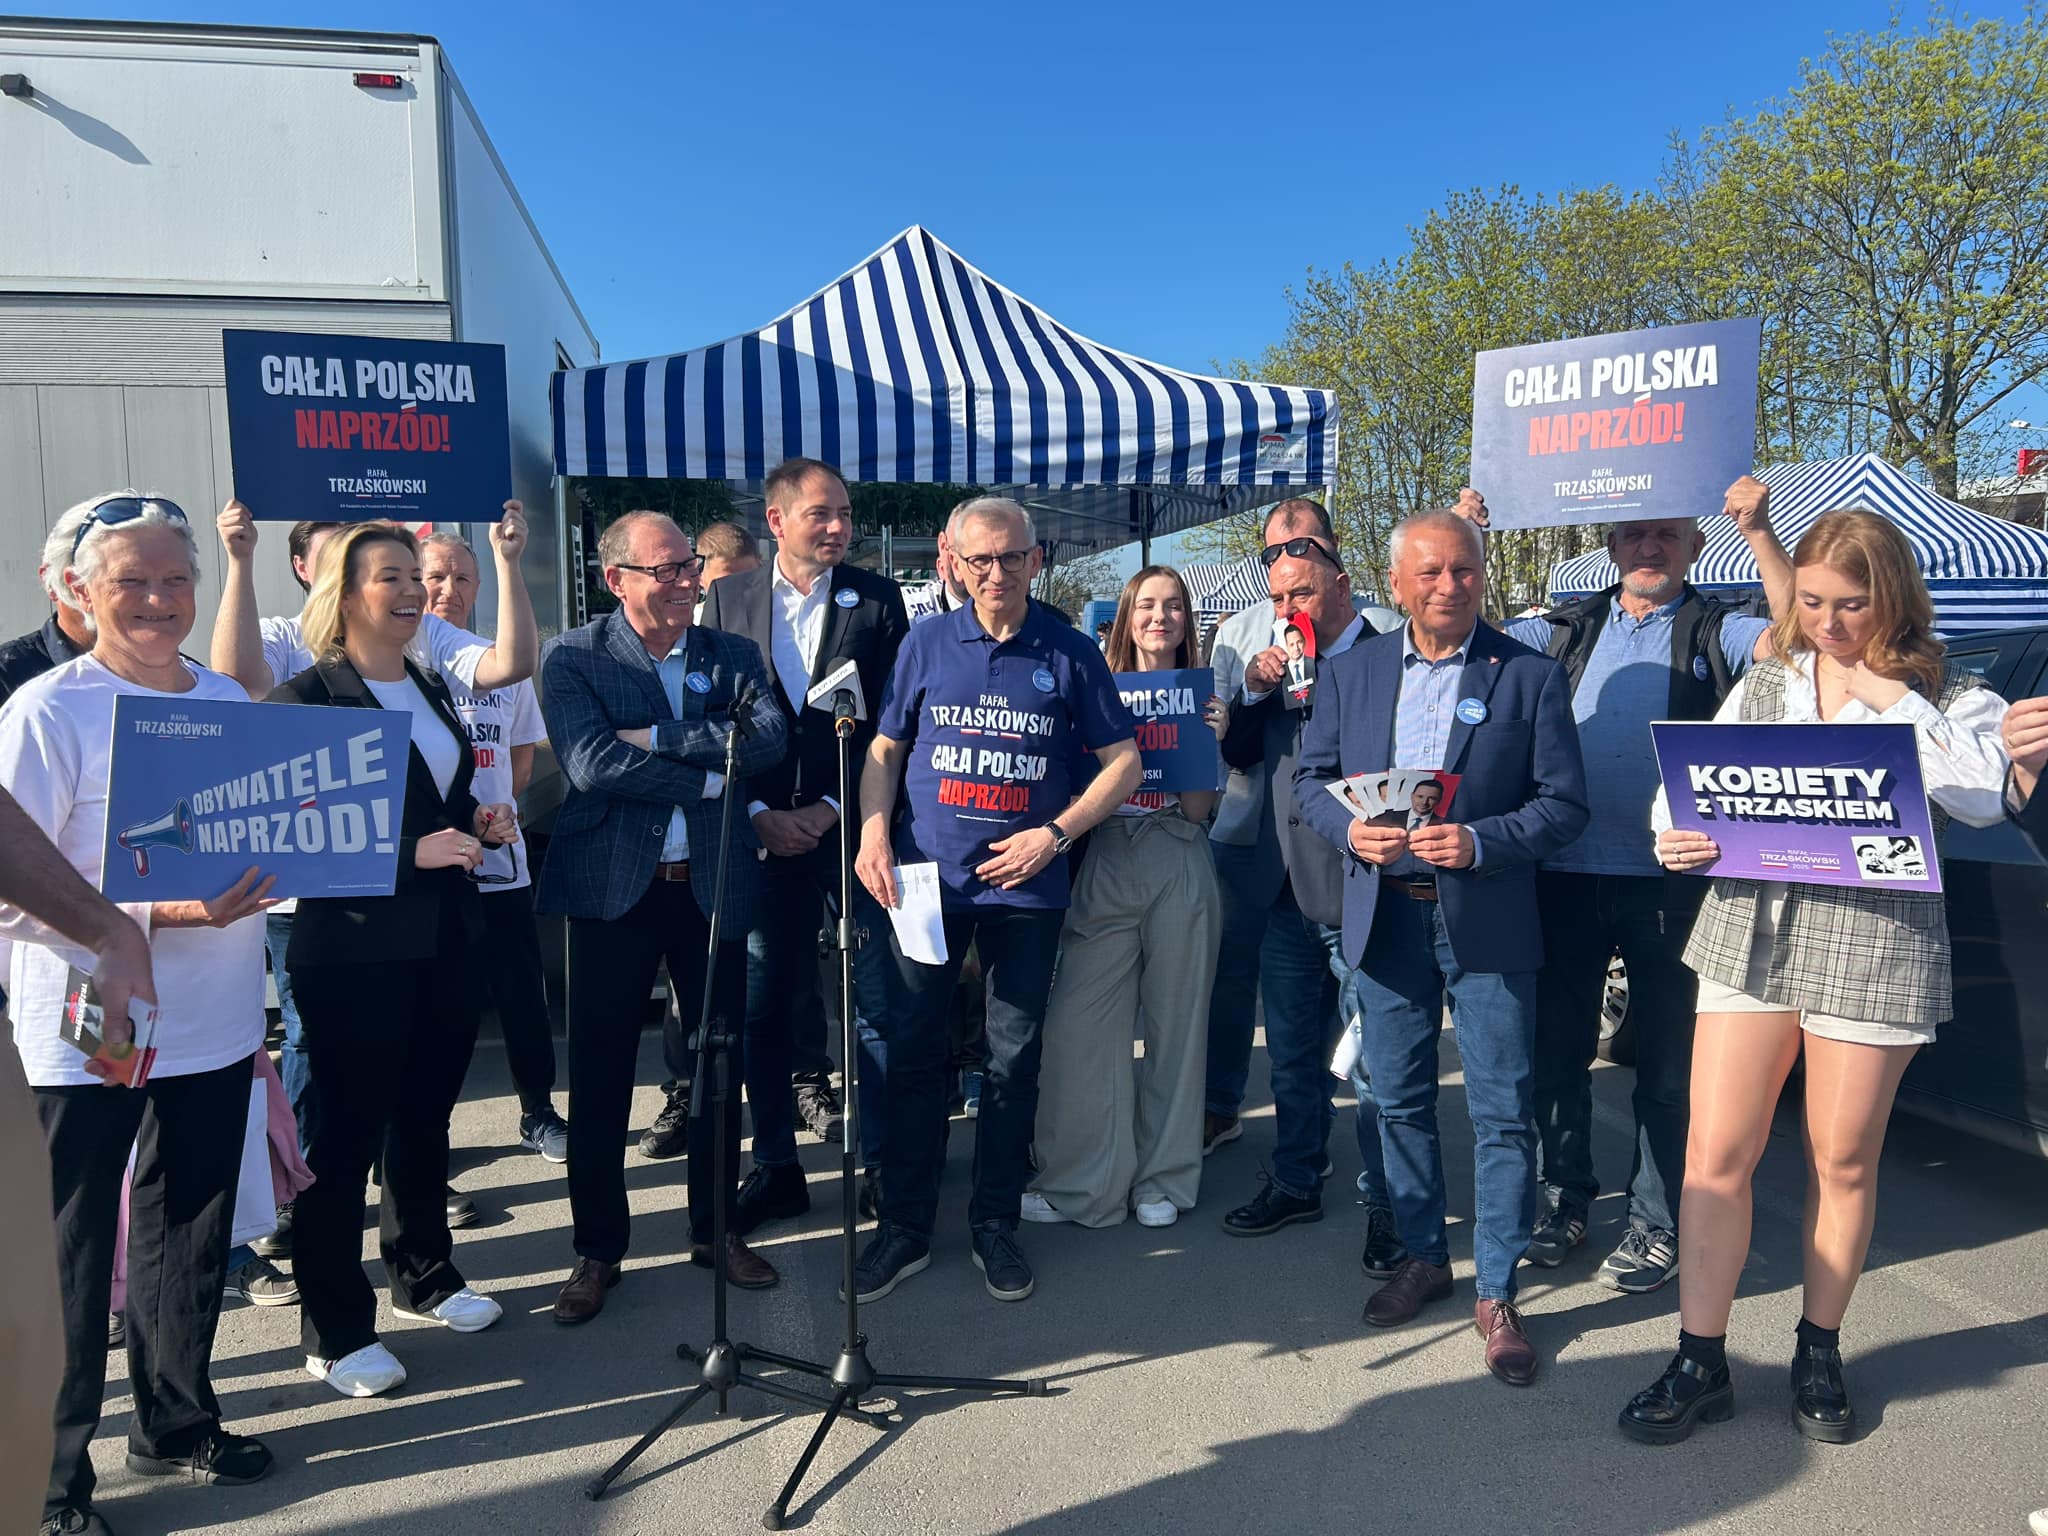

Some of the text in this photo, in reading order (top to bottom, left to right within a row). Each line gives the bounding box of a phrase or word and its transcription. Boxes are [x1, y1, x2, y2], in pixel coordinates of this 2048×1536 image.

[261, 355, 476, 403] CAŁA POLSKA
[1504, 345, 1718, 408] CAŁA POLSKA
[295, 401, 451, 452] NAPRZÓD!
[1528, 391, 1686, 457] NAPRZÓD!
[328, 478, 427, 494] TRZASKOWSKI
[367, 469, 389, 478] RAFAŁ
[1553, 474, 1653, 497] TRZASKOWSKI
[1591, 467, 1614, 478] RAFAŁ
[979, 694, 1009, 708] RAFAŁ
[134, 720, 222, 737] TRZASKOWSKI
[930, 705, 1054, 737] TRZASKOWSKI
[192, 727, 387, 816] OBYWATELE
[931, 744, 1048, 781] CAŁA POLSKA
[938, 778, 1030, 812] NAPRZÓD!
[1688, 765, 1888, 798] KOBIETY
[197, 795, 394, 854] NAPRZÓD!
[1716, 796, 1894, 821] TRZASKIEM
[1760, 853, 1841, 866] TRZASKOWSKI
